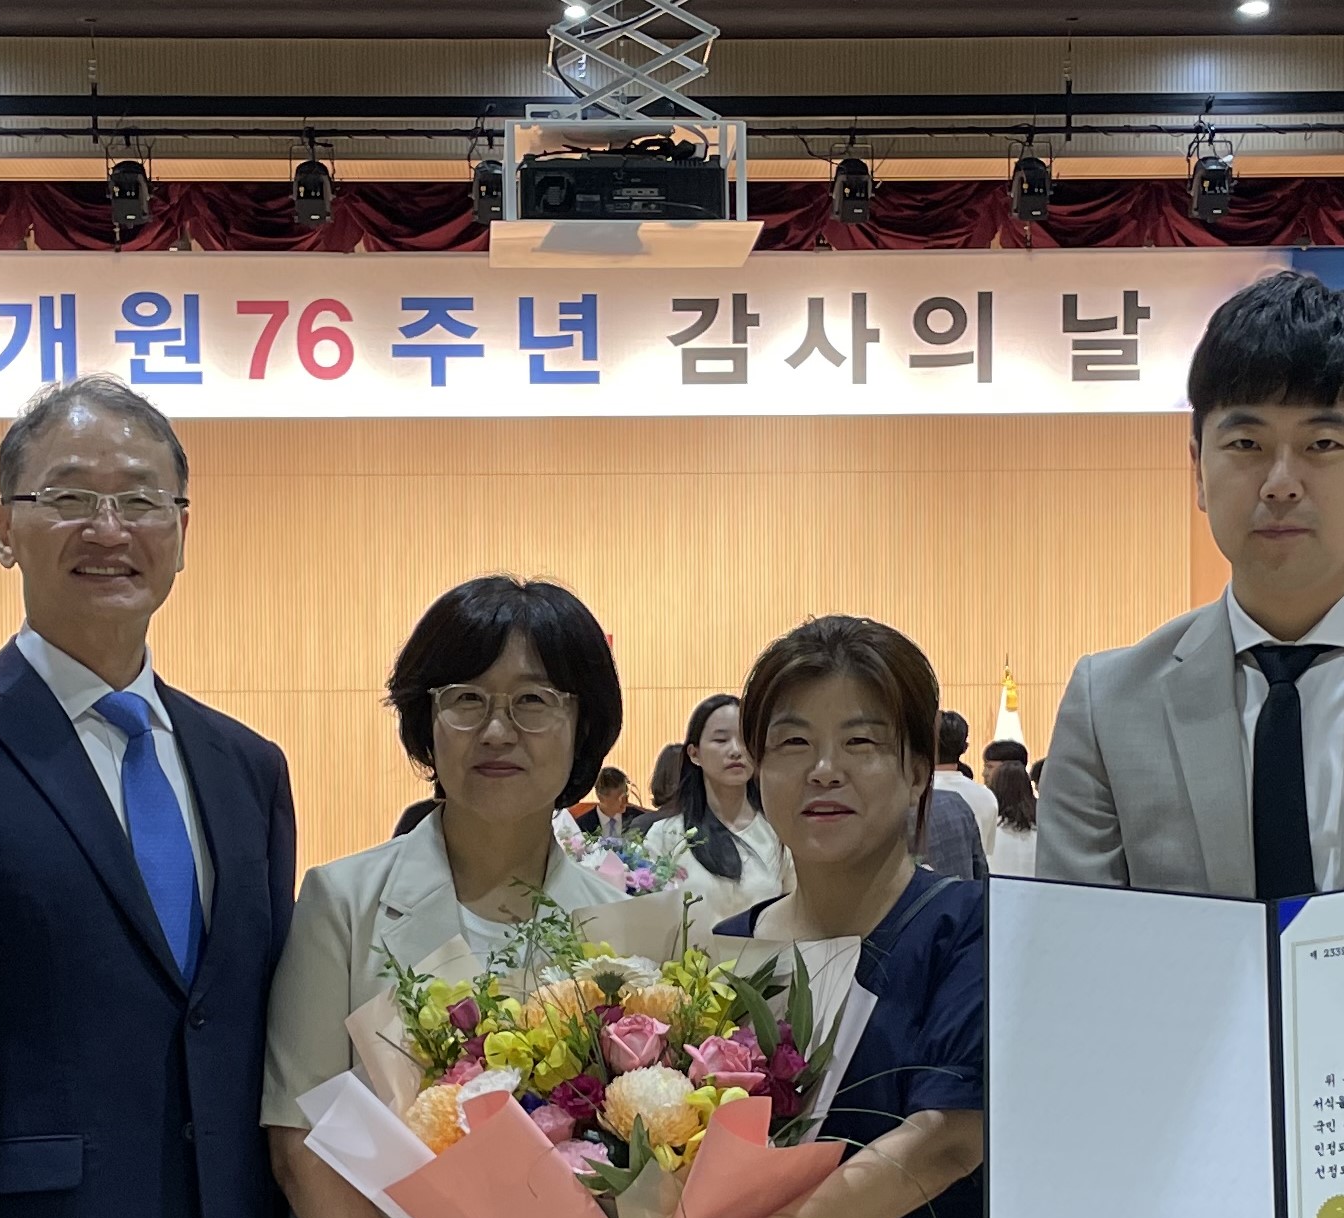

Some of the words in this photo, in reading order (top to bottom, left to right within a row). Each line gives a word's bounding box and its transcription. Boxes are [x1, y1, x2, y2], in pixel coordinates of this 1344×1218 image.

[666, 291, 993, 385] 감사의
[1060, 290, 1151, 381] 날
[1313, 1118, 1336, 1134] 국민
